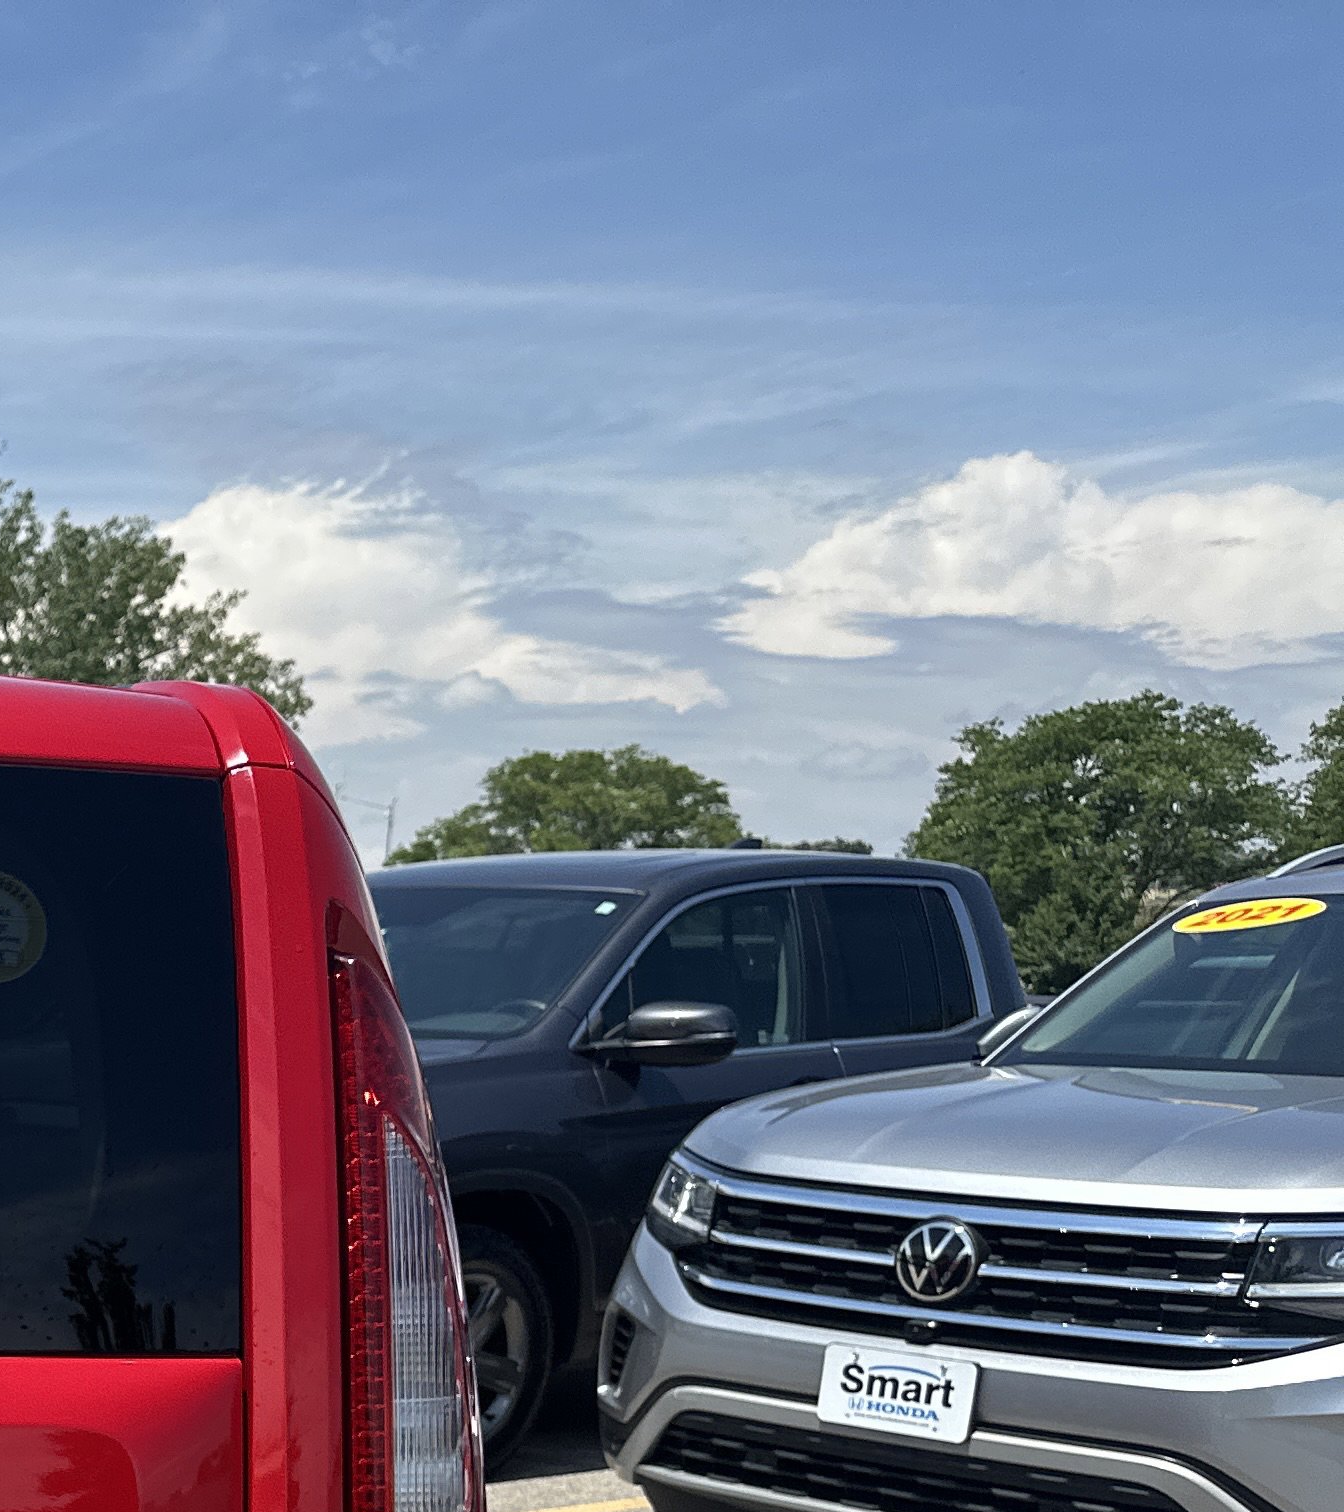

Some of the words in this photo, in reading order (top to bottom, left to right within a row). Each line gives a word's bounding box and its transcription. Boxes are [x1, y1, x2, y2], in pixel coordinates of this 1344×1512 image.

[1187, 903, 1310, 928] 2021
[840, 1363, 956, 1409] Smart
[867, 1400, 940, 1421] HONDA
